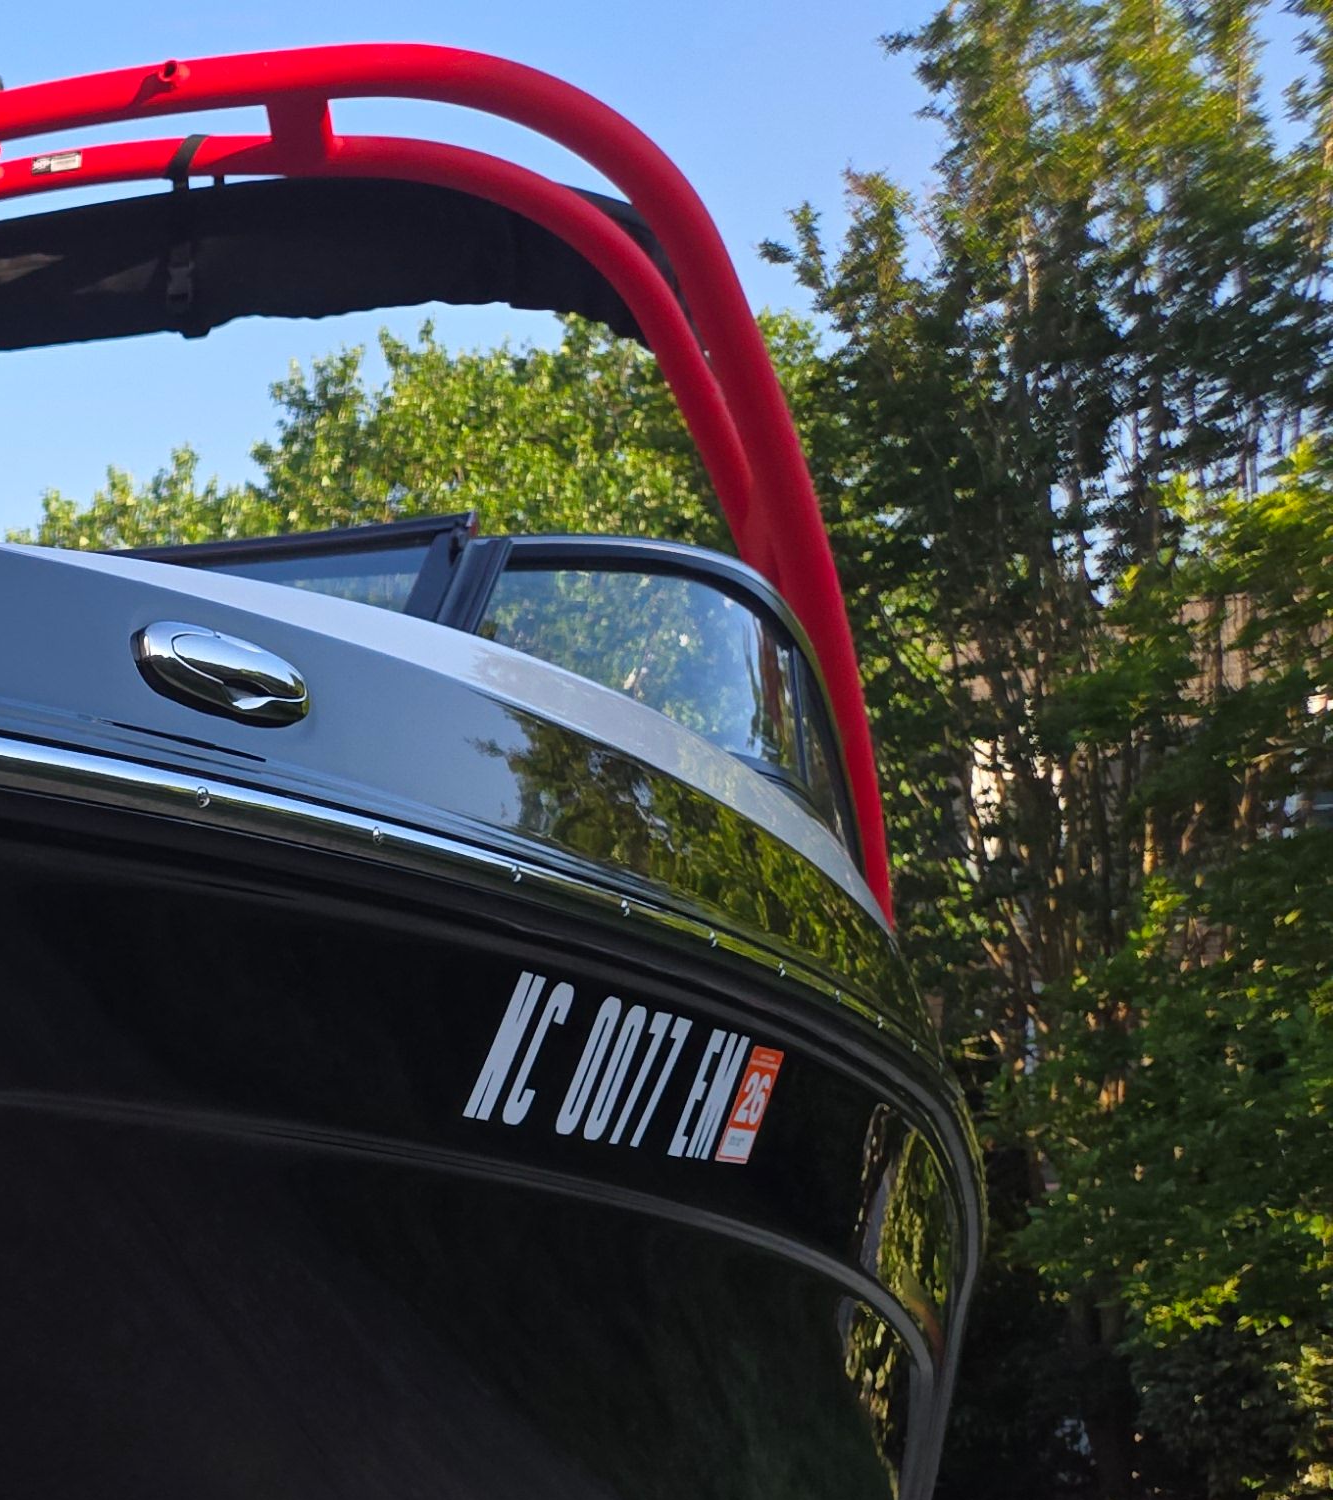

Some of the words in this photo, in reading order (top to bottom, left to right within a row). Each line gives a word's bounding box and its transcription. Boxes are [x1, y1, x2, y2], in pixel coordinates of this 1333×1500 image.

[462, 971, 575, 1125] NC
[555, 996, 693, 1147] 0077
[733, 1071, 772, 1125] 26
